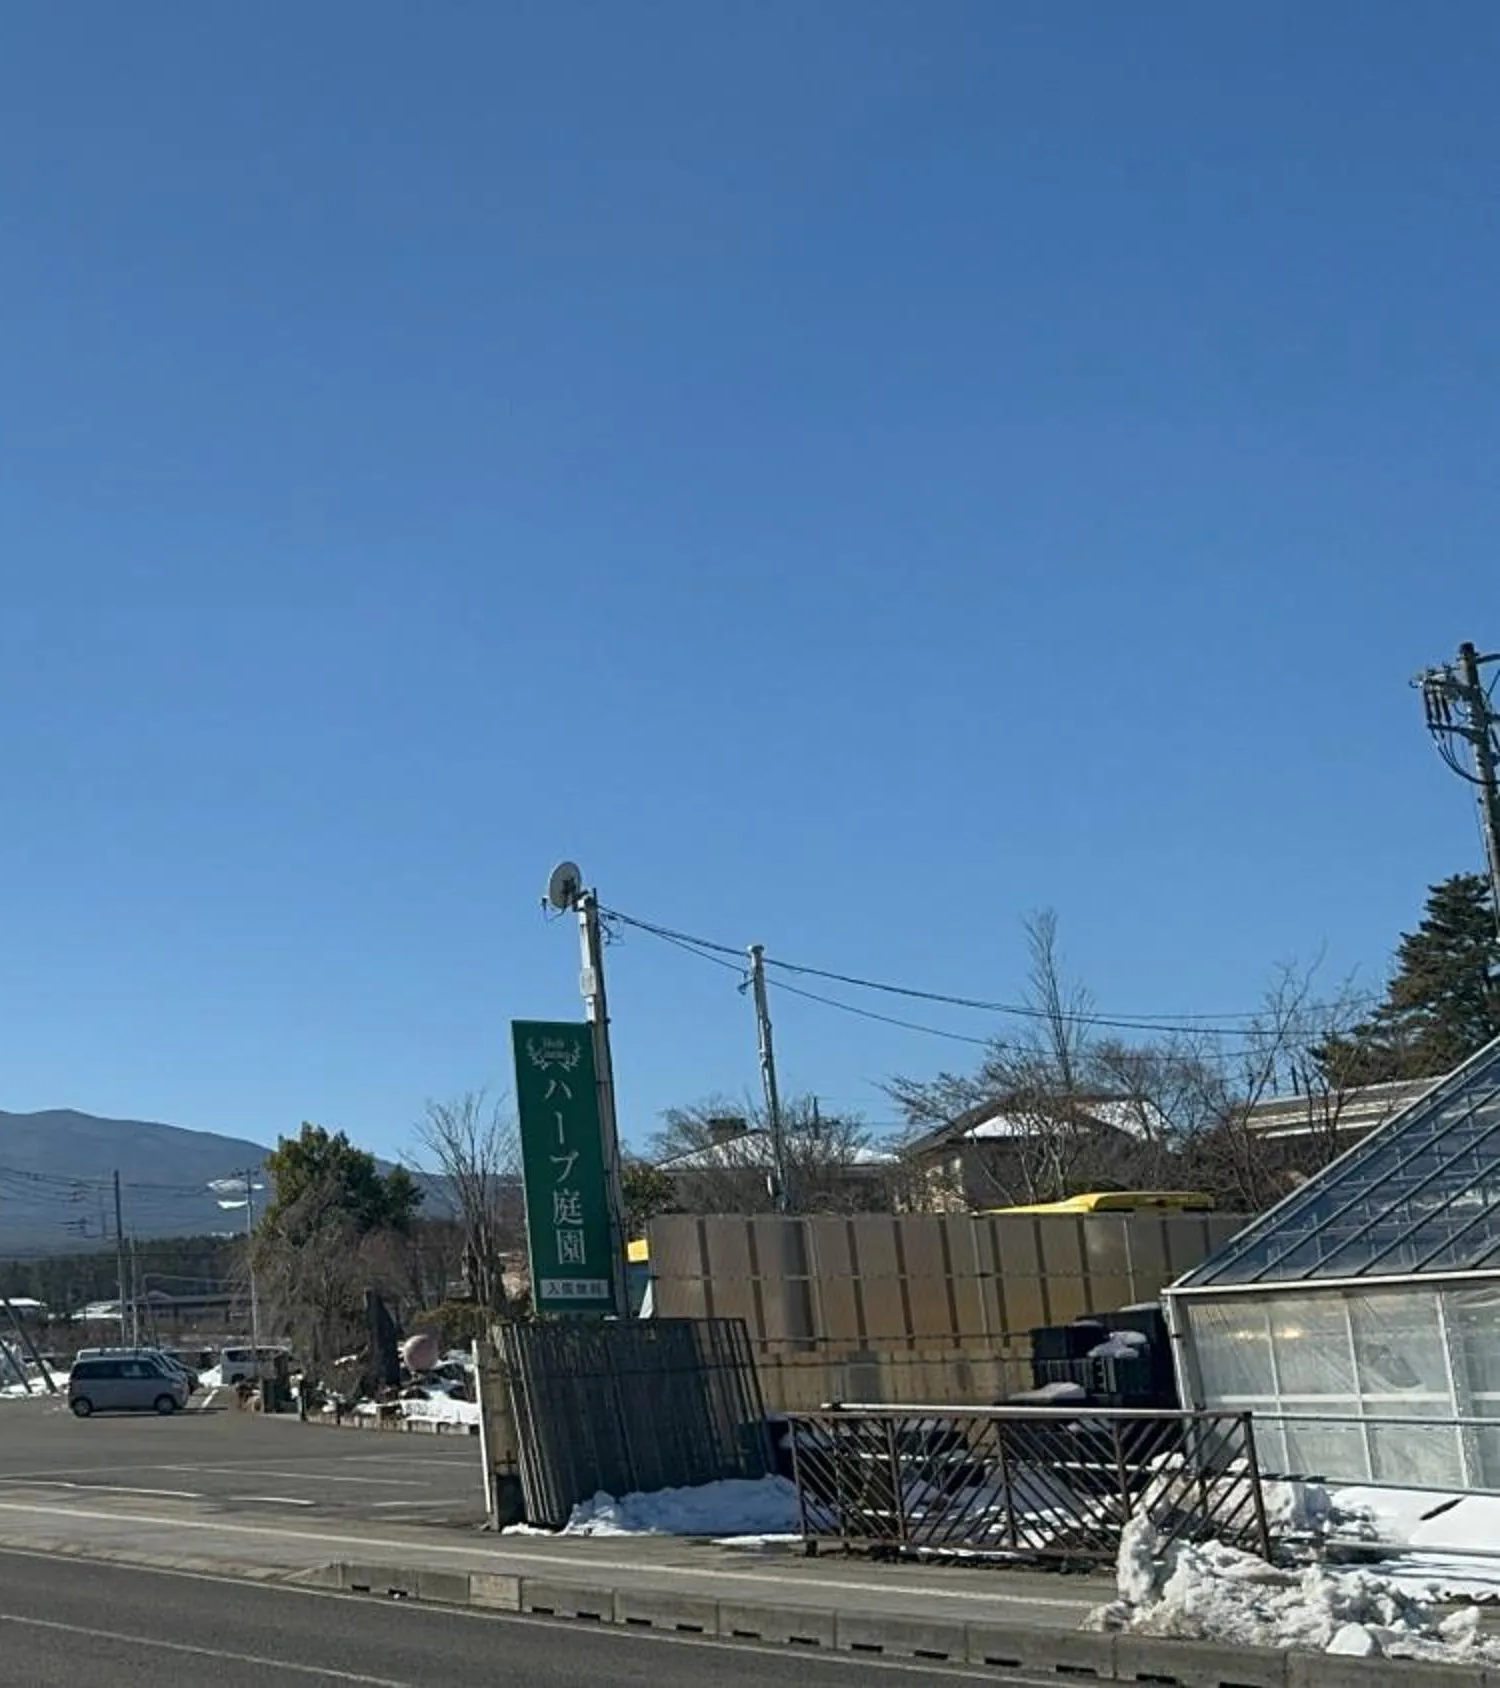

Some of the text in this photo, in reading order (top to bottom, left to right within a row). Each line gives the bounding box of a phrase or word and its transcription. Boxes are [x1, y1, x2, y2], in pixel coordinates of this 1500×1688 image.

[544, 1079, 586, 1265] ハーブ庭園
